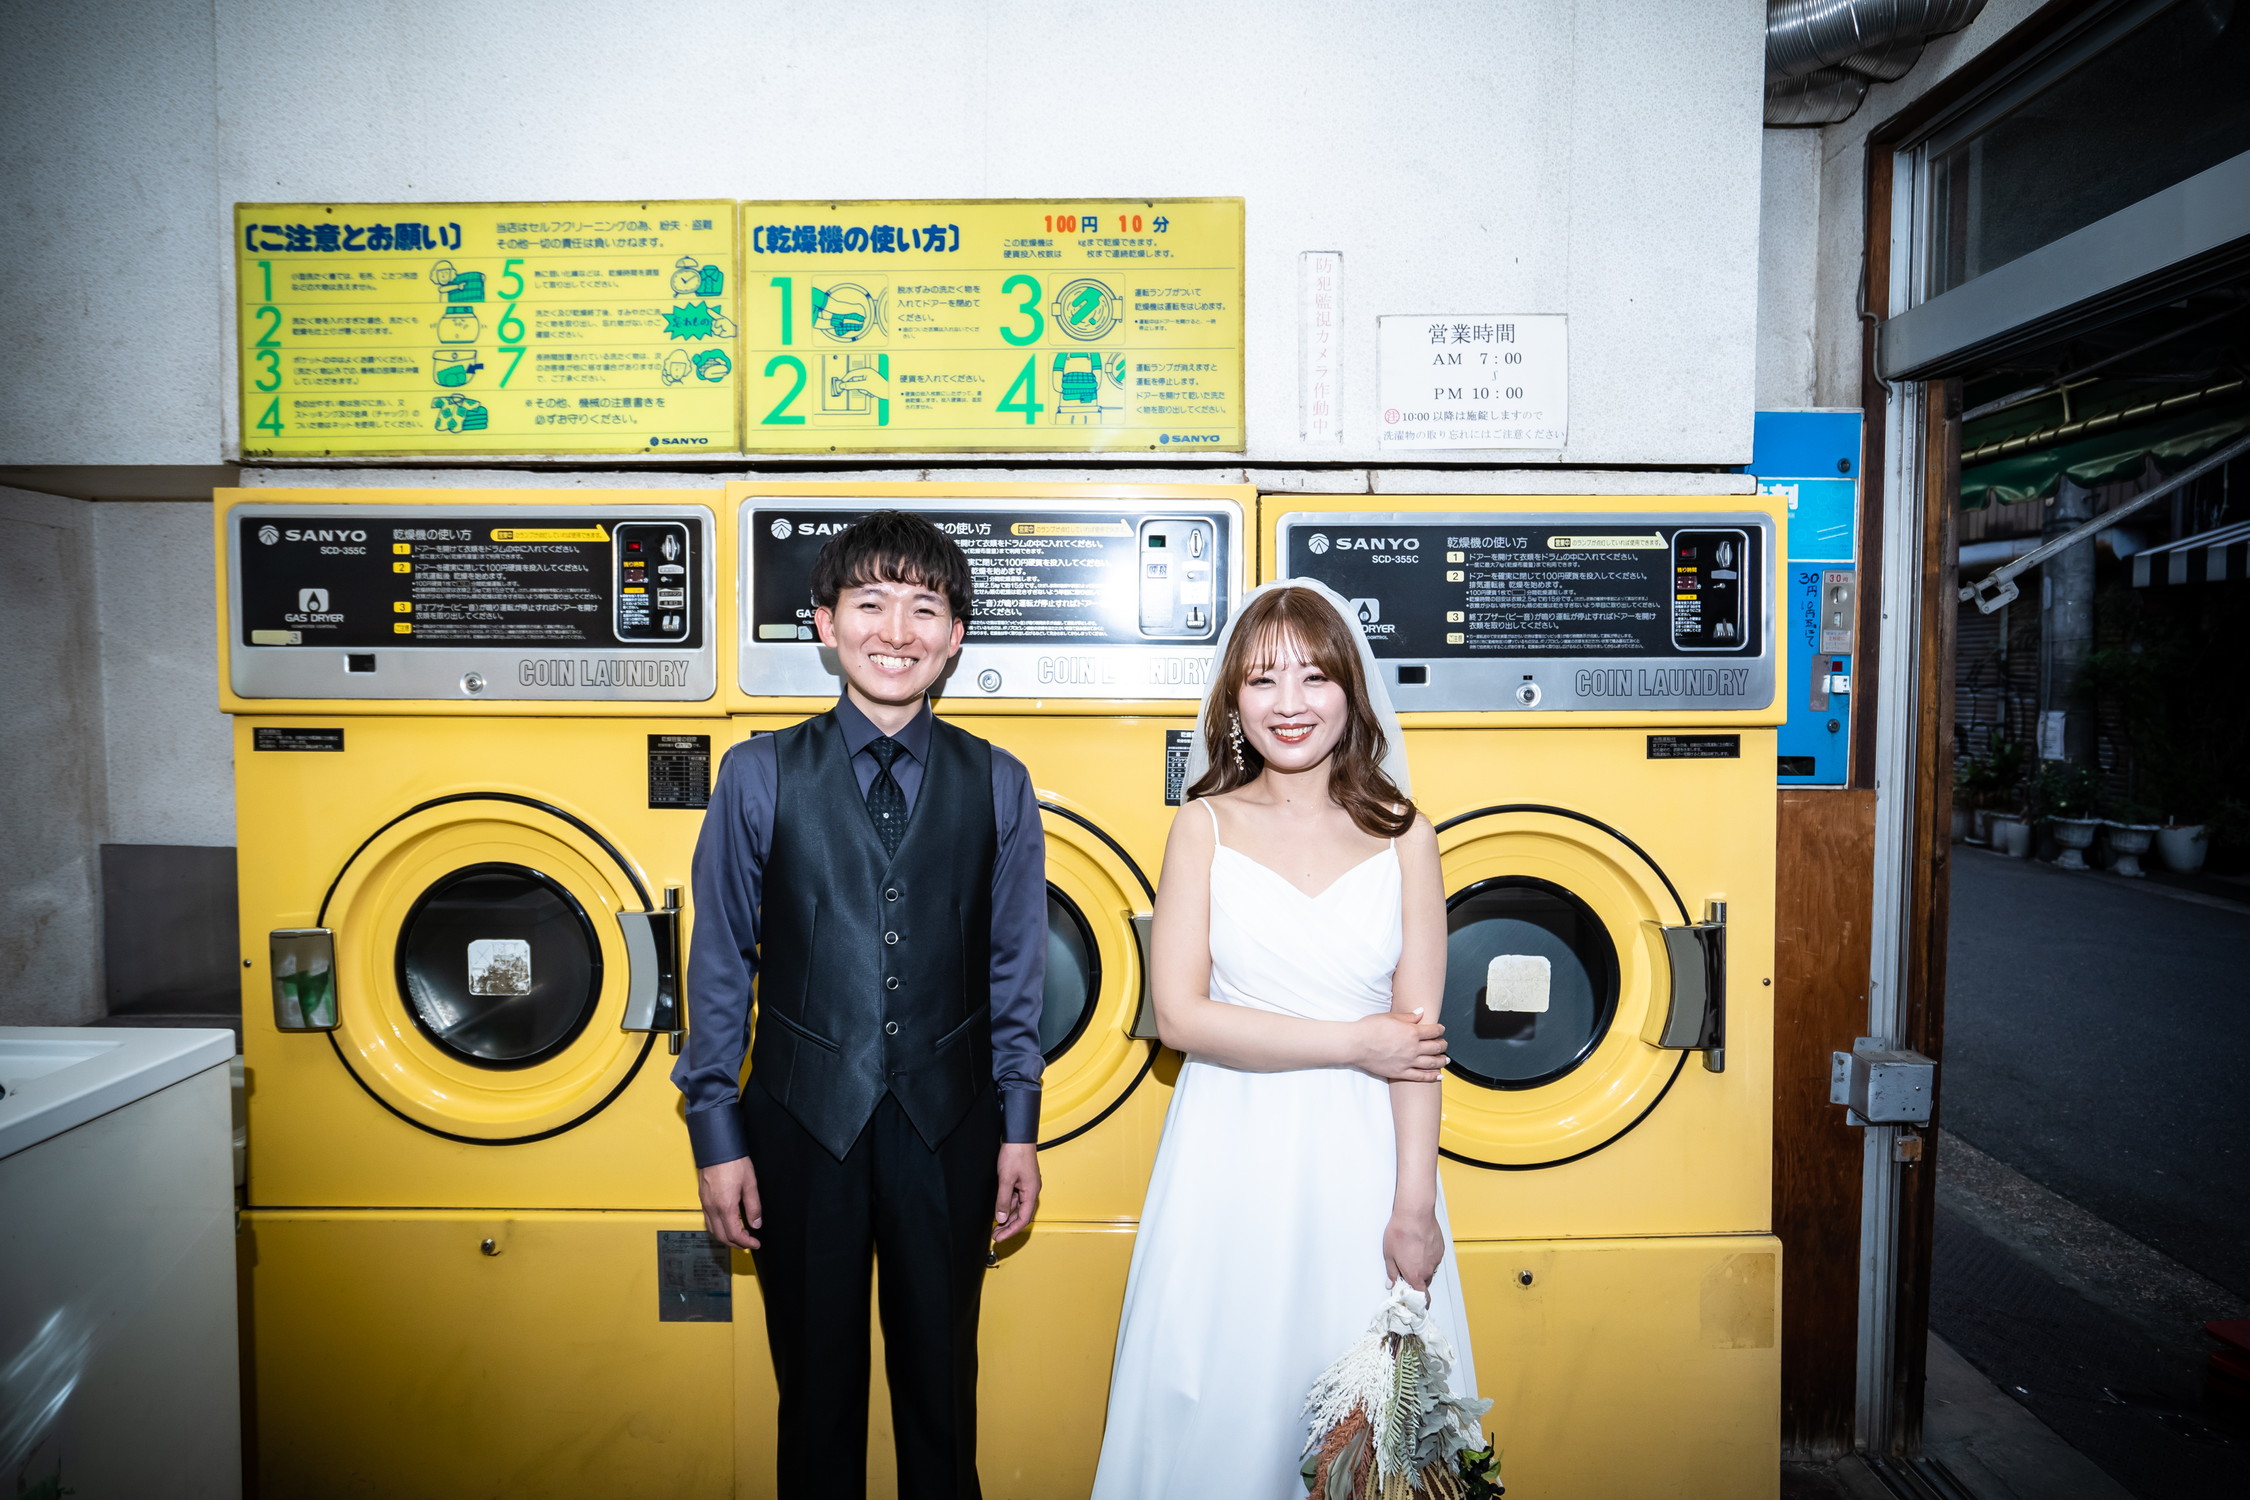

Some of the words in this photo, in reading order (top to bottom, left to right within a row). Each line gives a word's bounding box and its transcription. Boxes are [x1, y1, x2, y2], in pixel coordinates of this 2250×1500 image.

[496, 237, 664, 249] その他一切の責任は負いかねます。
[1003, 239, 1053, 248] この乾燥機は
[1003, 250, 1062, 259] 硬貨投入枚数は
[258, 261, 272, 302] 1
[497, 259, 524, 300] 5
[1135, 288, 1202, 297] 運転ランプがついて
[770, 277, 793, 346] 1
[1000, 274, 1044, 346] 3
[1135, 302, 1227, 311] 乾燥機は運転をはじめます。
[497, 303, 525, 344] 6
[897, 313, 935, 322] ください。
[256, 306, 282, 347] 2
[1428, 323, 1516, 344] 営業時間
[1432, 353, 1463, 365] AM
[255, 350, 282, 391] 3
[498, 347, 527, 388] 7
[1136, 363, 1218, 372] 運転ランプが消えますと
[900, 374, 986, 383] 硬貨を入れてください。
[1136, 377, 1200, 386] 運転を停止します。
[760, 355, 807, 425] 2
[995, 353, 1044, 425] 4
[1434, 387, 1463, 400] PM
[1137, 405, 1227, 414] く物を取り出してください。
[257, 396, 284, 437] 4
[1432, 411, 1543, 422] 以降は施錠しますので
[661, 437, 708, 445] SANYO
[393, 529, 472, 541] 乾燥機の使い方
[798, 523, 848, 536] SAN
[944, 523, 992, 535] の使い方
[285, 529, 367, 542] SANYO
[1336, 538, 1420, 550] SANYO
[1447, 537, 1528, 549] 乾燥機の使い方
[320, 547, 366, 555] SCD-355C
[1372, 555, 1419, 564] SCD-355C
[285, 614, 307, 622] GAS
[311, 614, 344, 622] DRYER
[519, 659, 575, 687] COIN
[580, 659, 689, 687] LAUNDRY
[1037, 656, 1096, 684] COIN
[1575, 669, 1633, 697] COIN
[1638, 669, 1750, 697] LAUNDRY
